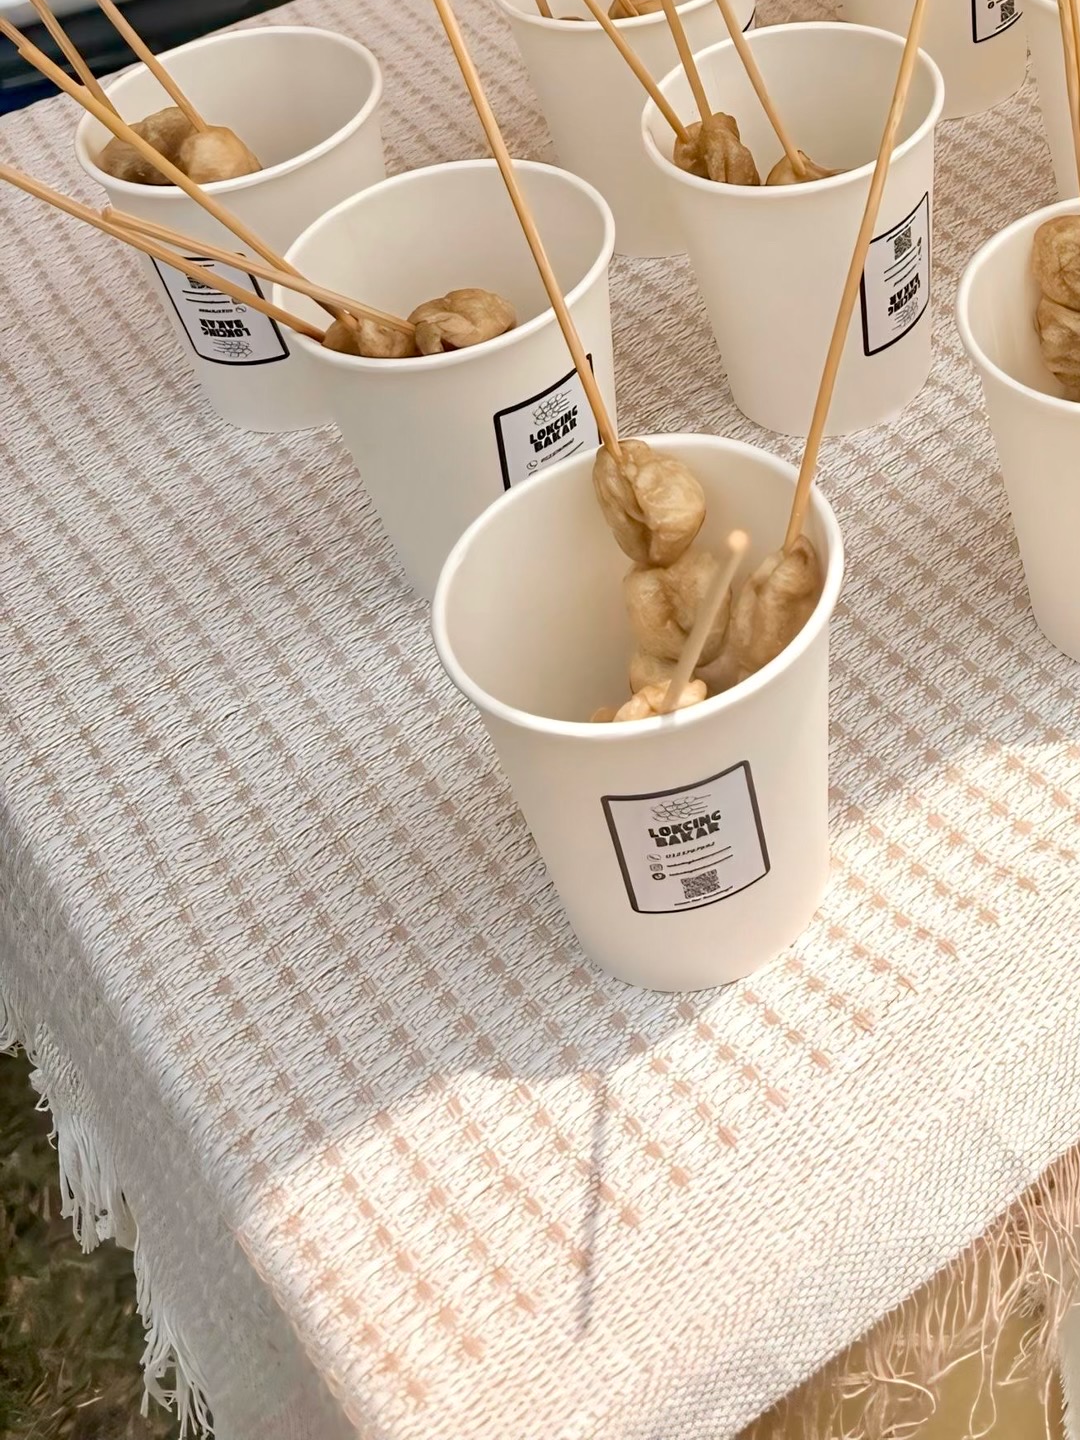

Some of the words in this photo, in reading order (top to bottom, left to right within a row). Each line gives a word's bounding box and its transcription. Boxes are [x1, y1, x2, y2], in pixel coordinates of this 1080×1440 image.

[199, 318, 244, 329] BAKAR
[529, 405, 578, 445] LOKCING
[534, 418, 578, 453] BAKAR
[648, 810, 722, 839] LOKCING
[655, 822, 720, 848] BAKAR
